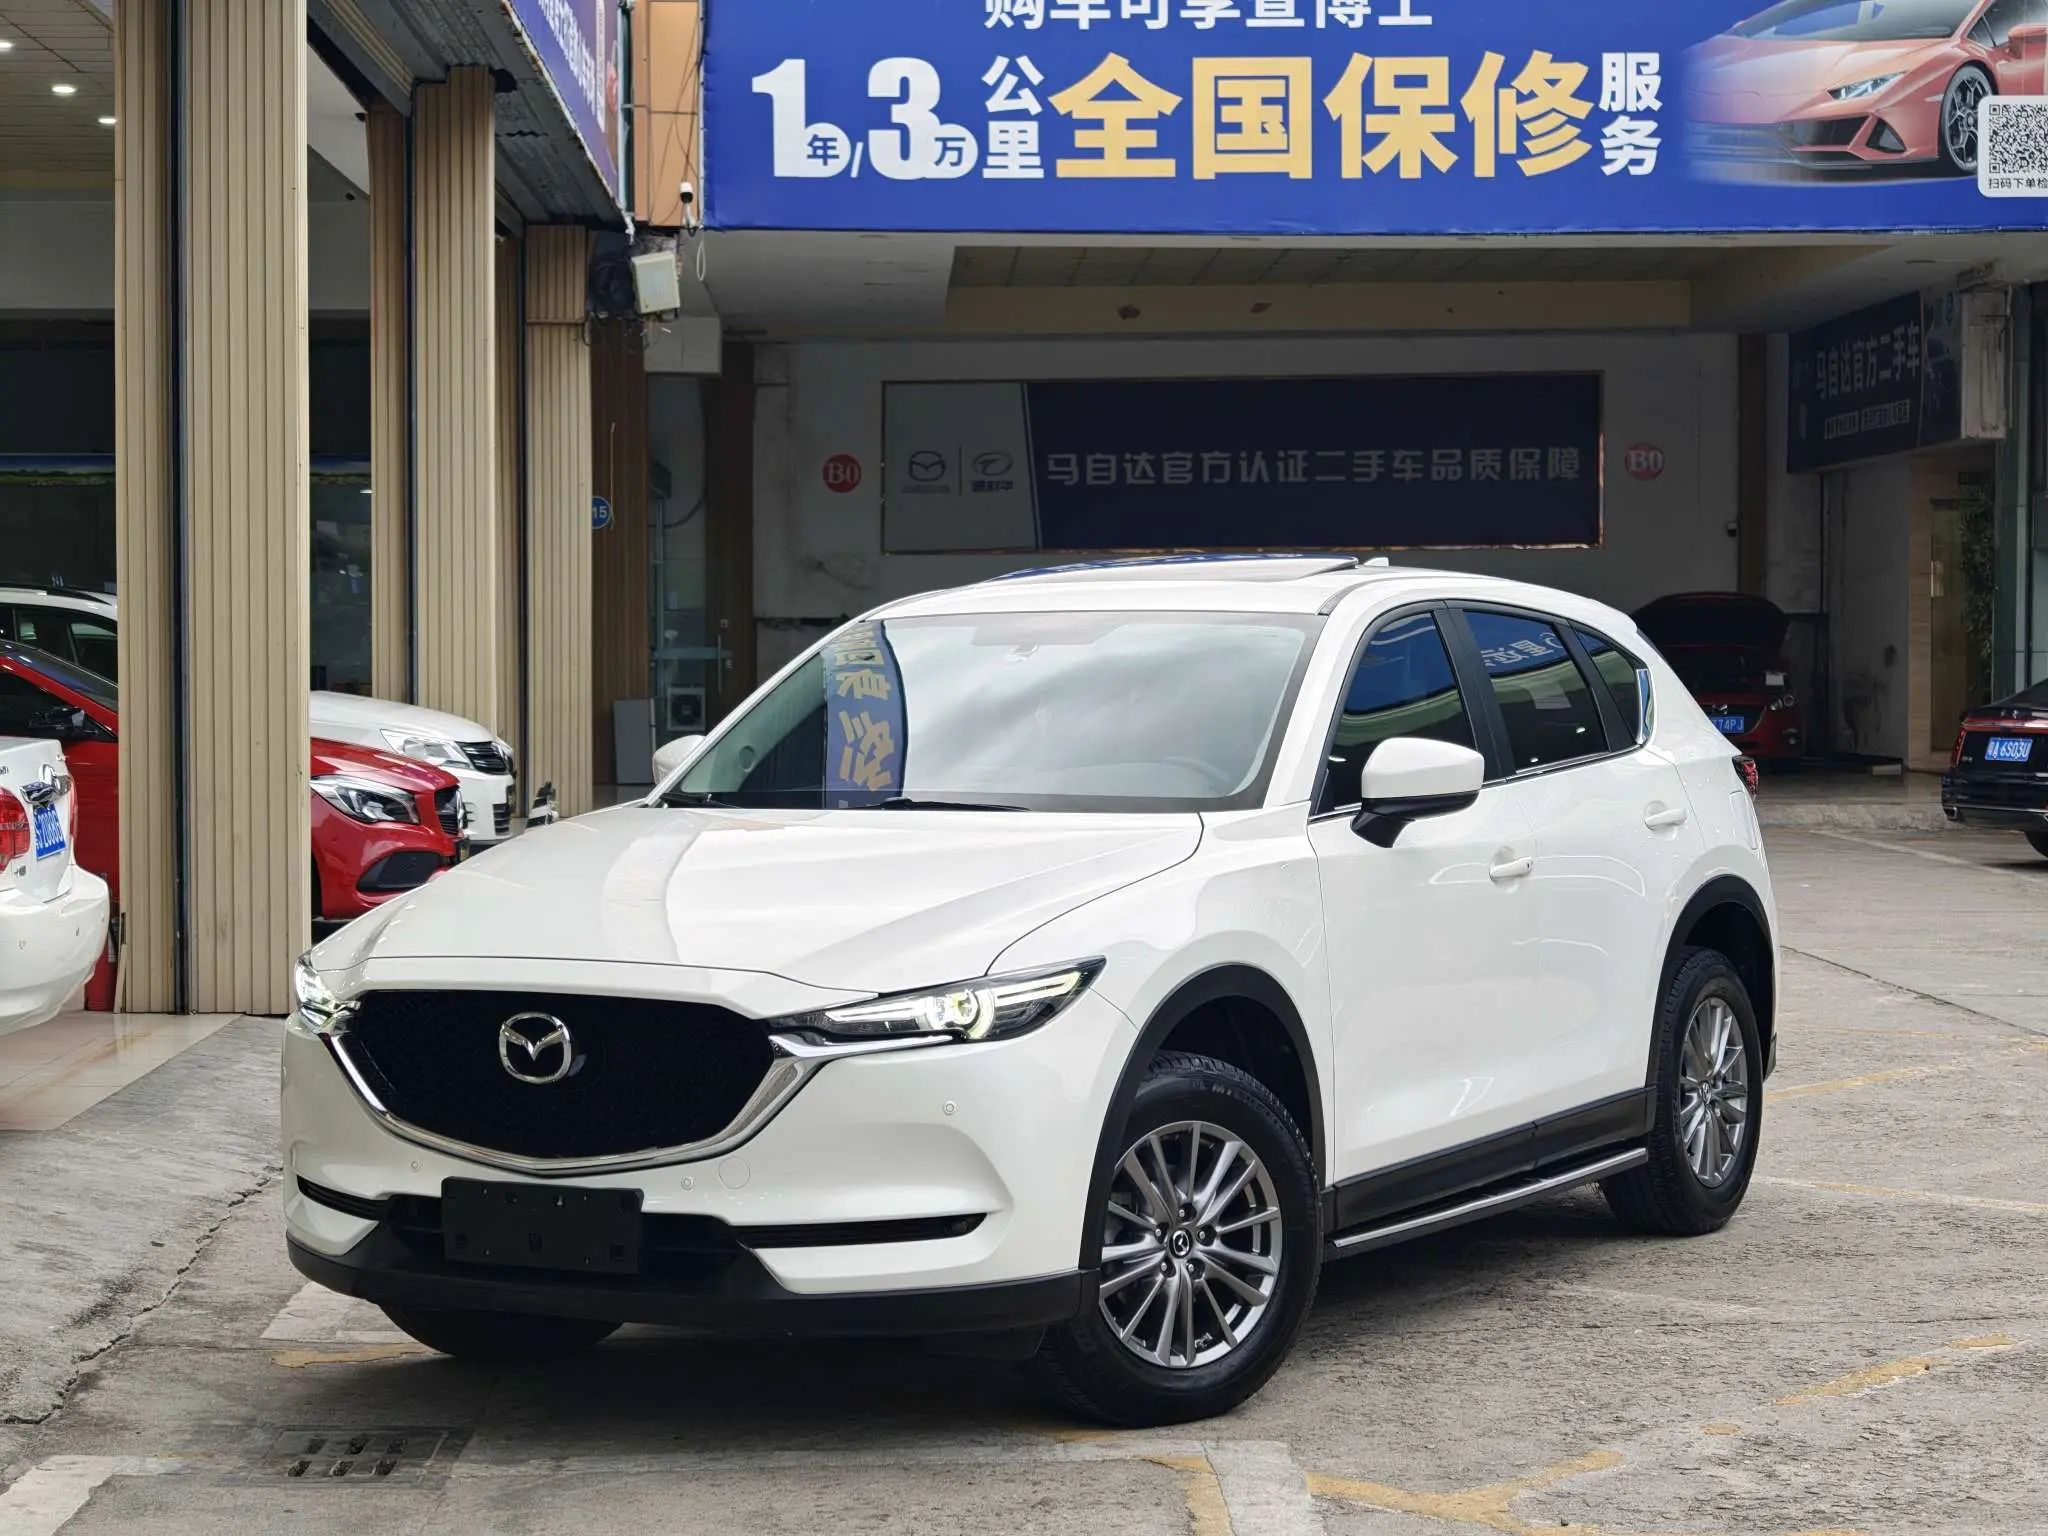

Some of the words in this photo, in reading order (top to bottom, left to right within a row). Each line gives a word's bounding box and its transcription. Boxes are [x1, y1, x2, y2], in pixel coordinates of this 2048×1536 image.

[1815, 319, 1921, 401] 马自达官方二手车
[1046, 445, 1580, 486] 马自达官方认证二手车品质保障
